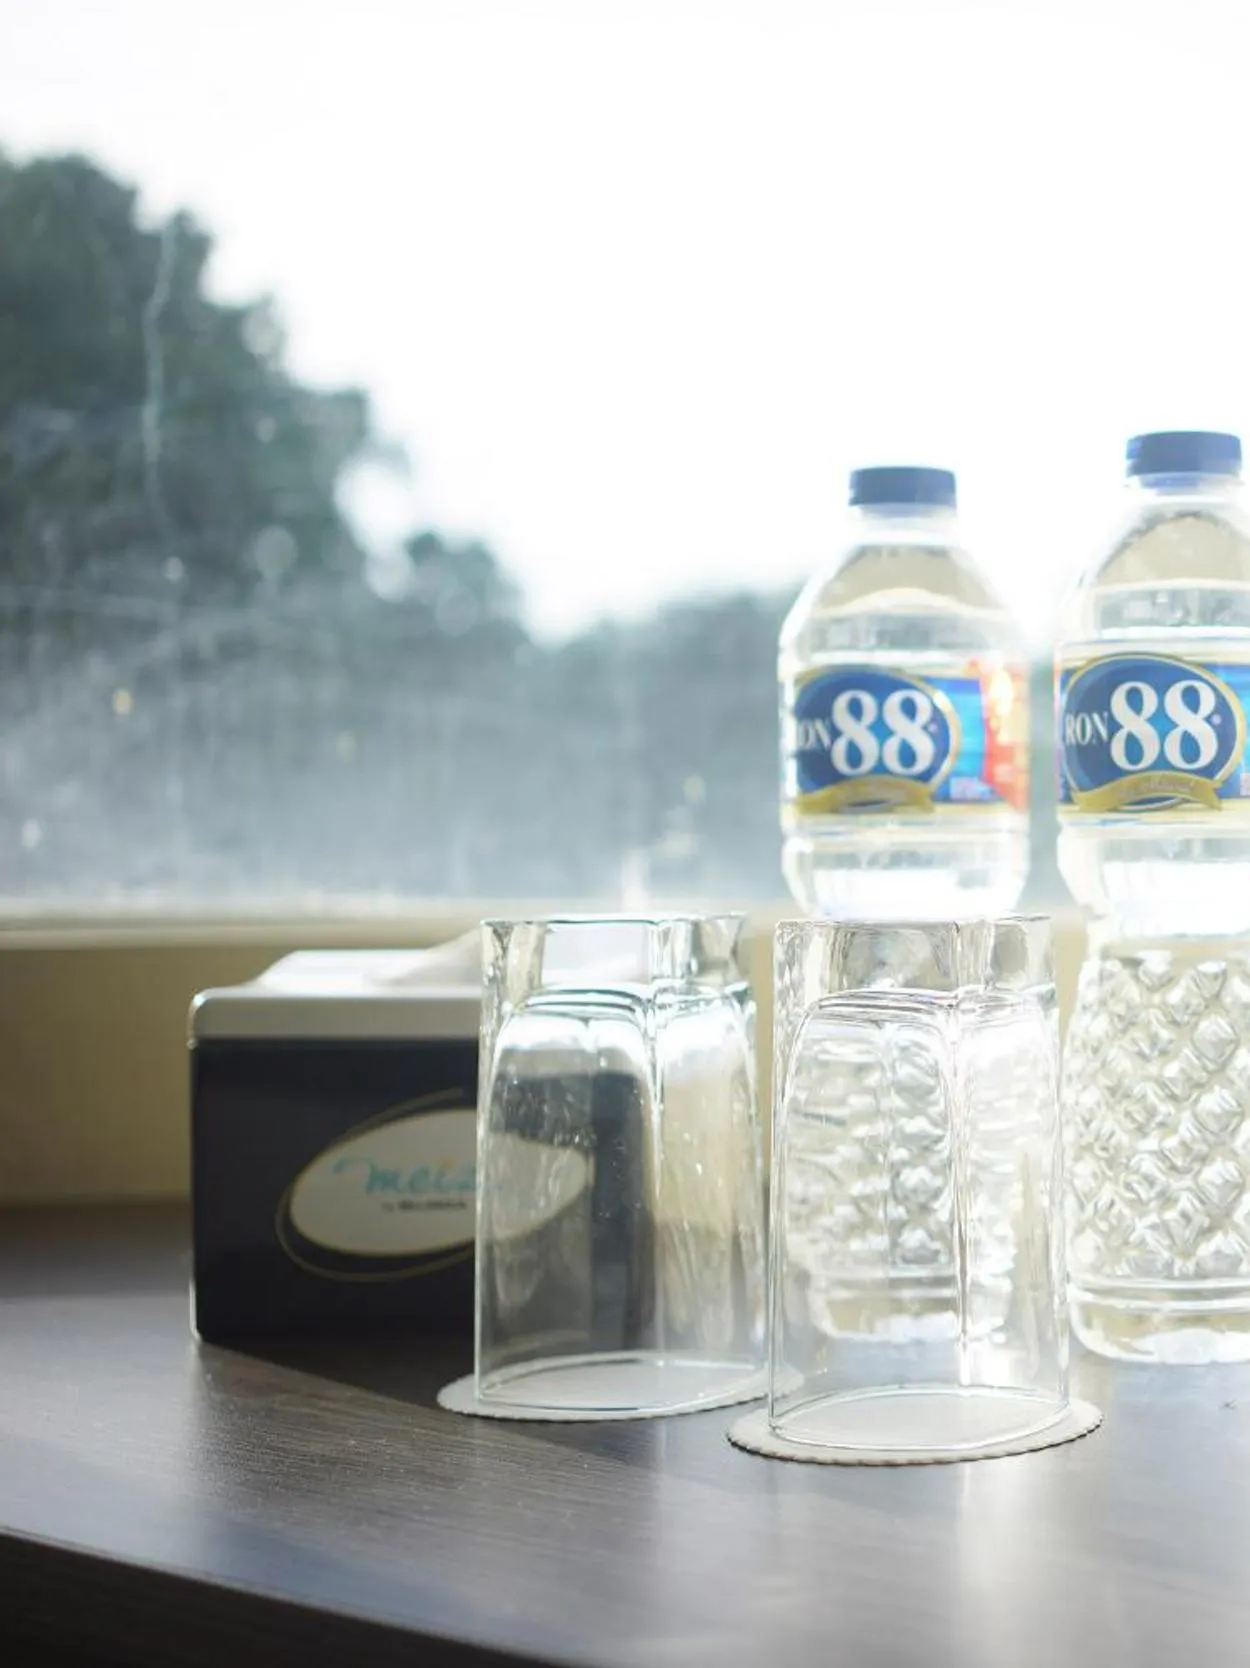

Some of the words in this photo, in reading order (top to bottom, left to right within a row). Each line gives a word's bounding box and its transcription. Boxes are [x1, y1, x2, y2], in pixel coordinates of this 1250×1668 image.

[831, 689, 934, 776] 88
[1065, 711, 1109, 746] RON
[1110, 680, 1218, 771] 88
